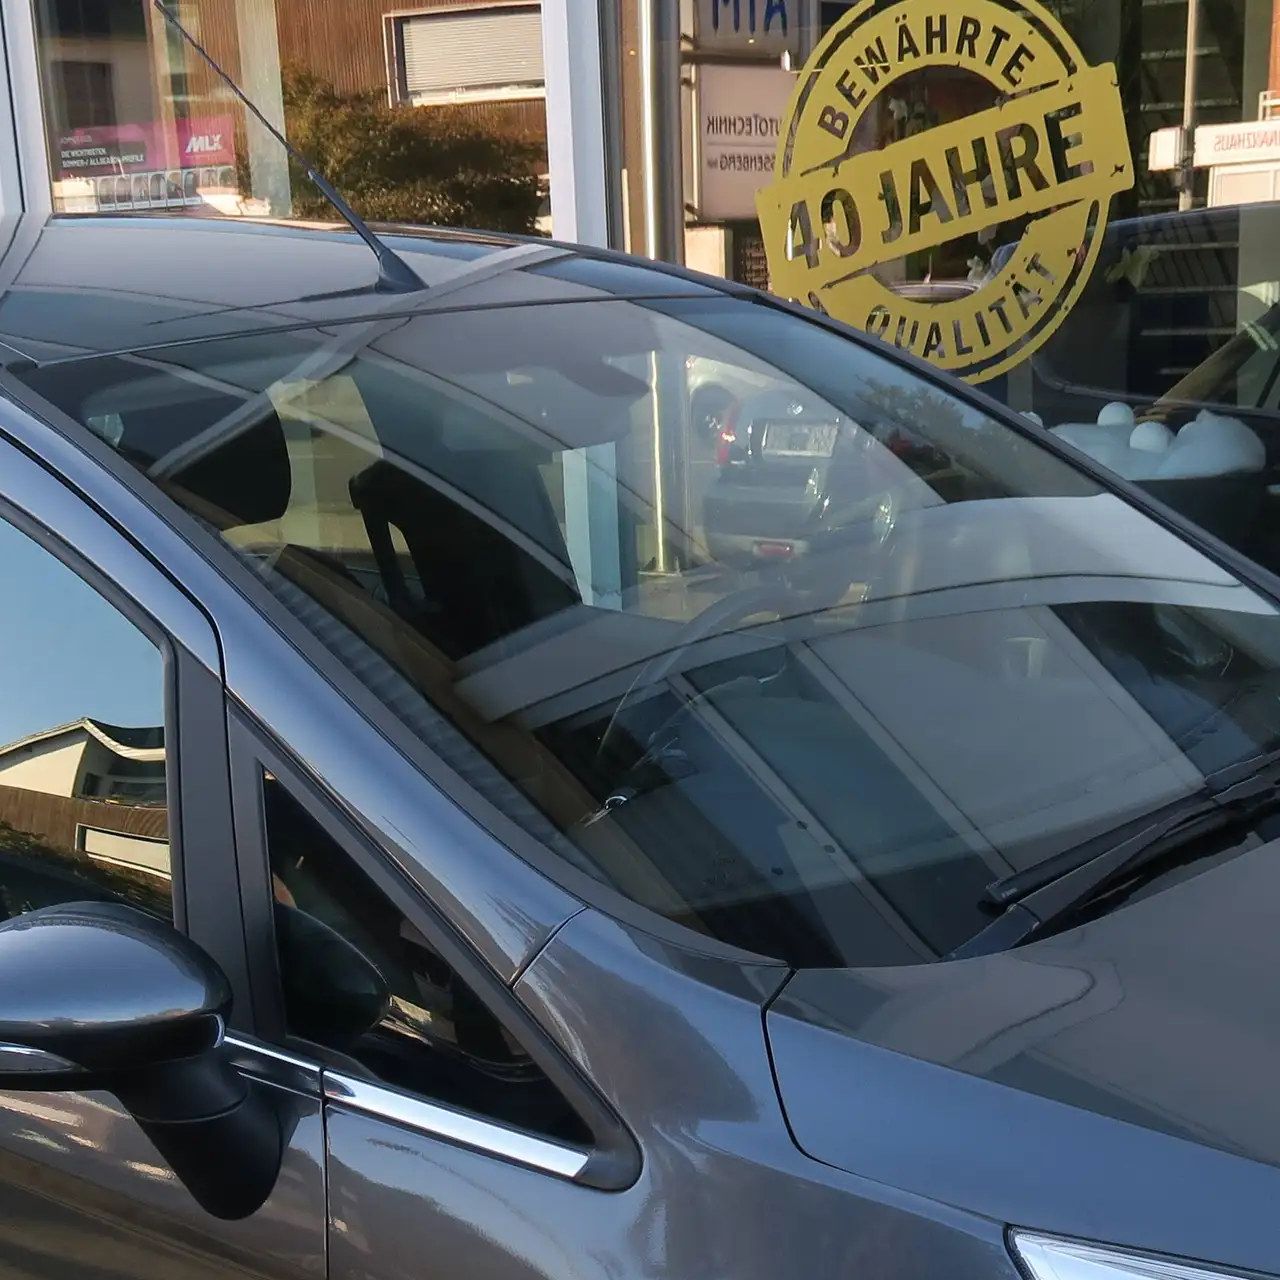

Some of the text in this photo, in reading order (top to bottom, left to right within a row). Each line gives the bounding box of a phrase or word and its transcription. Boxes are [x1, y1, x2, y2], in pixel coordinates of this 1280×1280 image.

[817, 14, 1035, 140] BEWÄHRTE
[185, 133, 223, 153] MLX
[784, 102, 1095, 269] 40 JAHRE
[865, 252, 1056, 359] QUALITÄT
